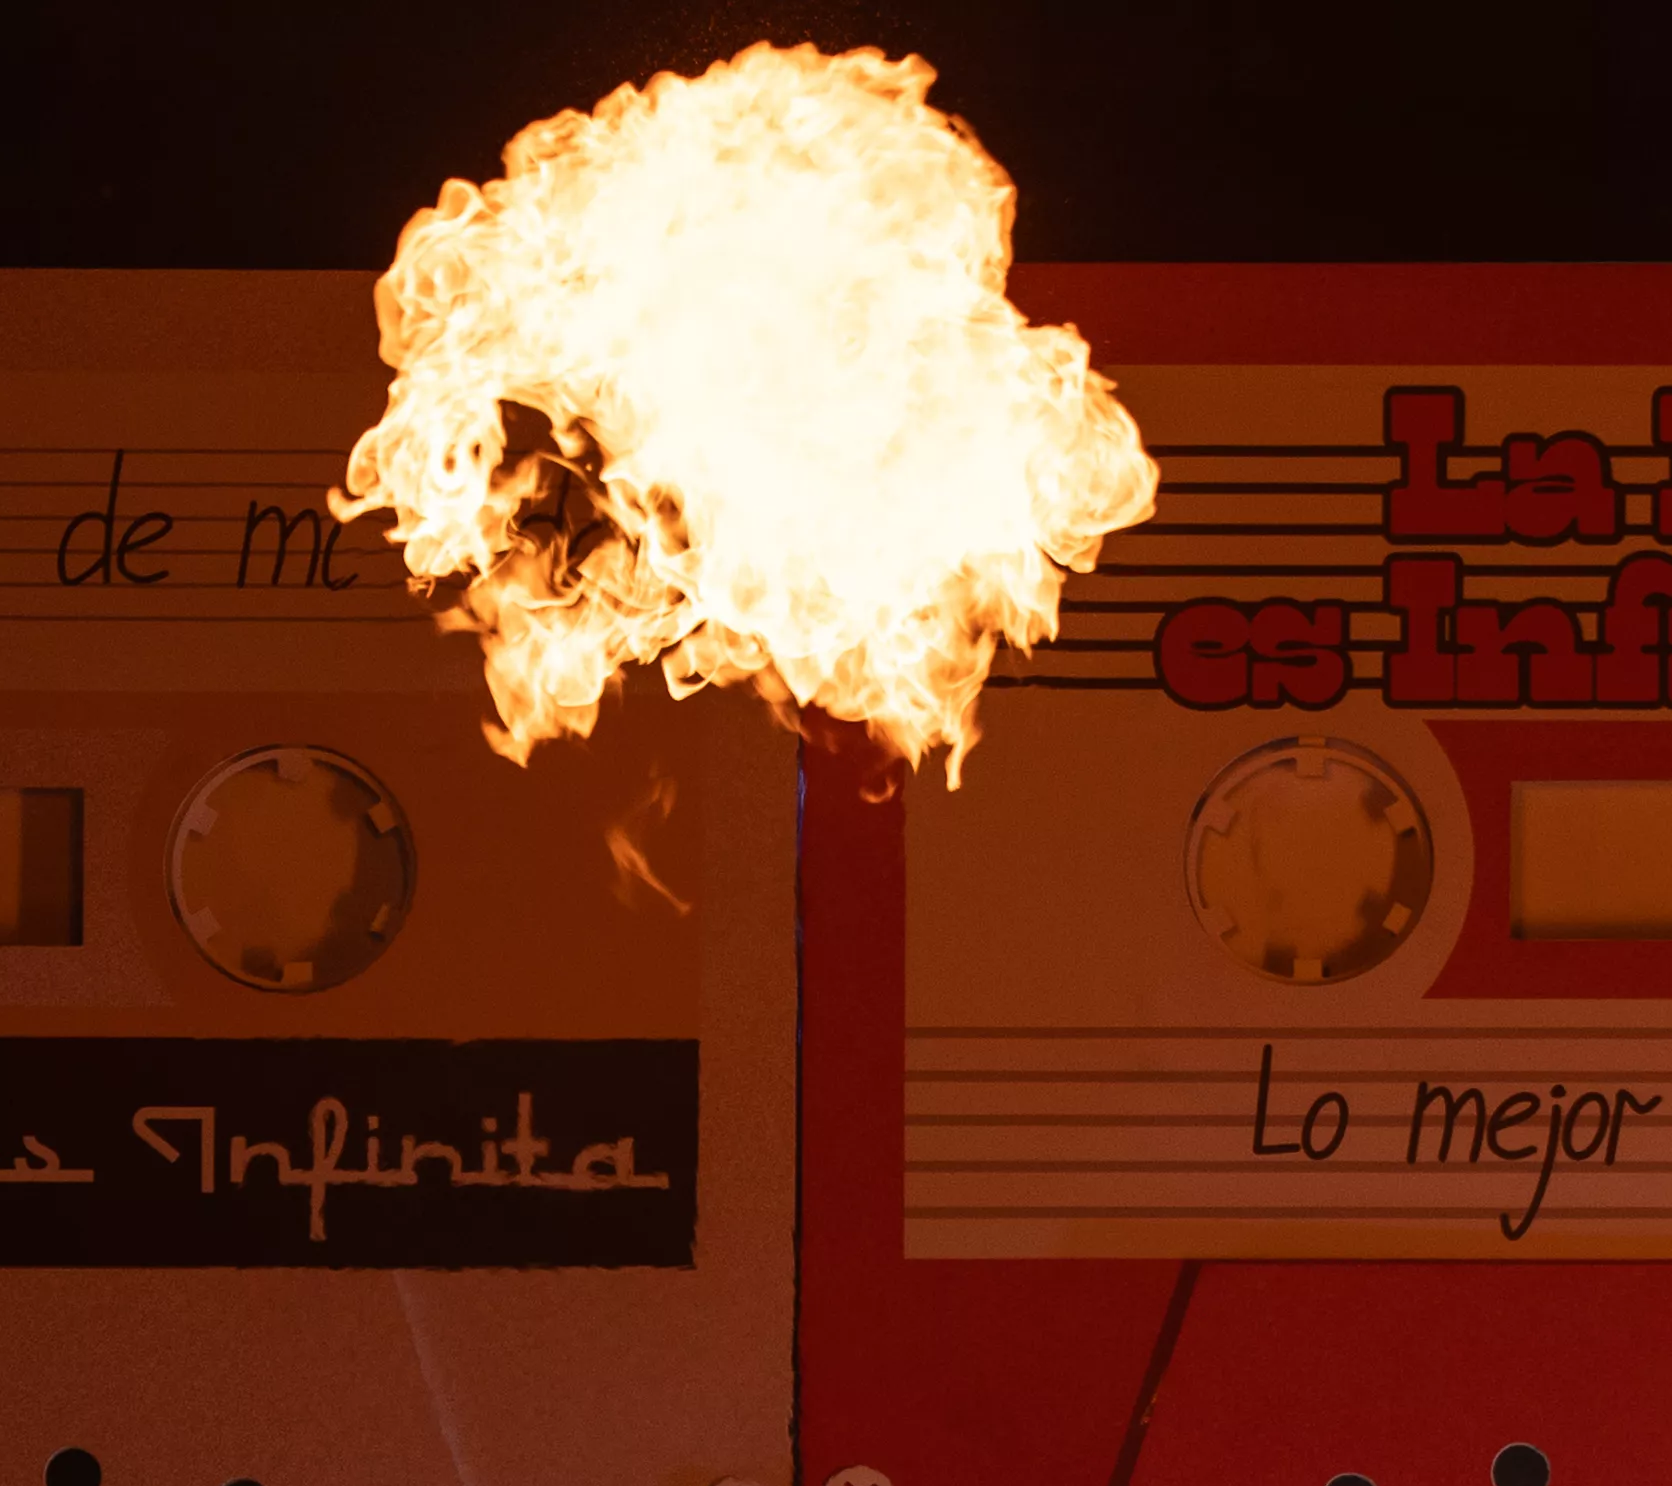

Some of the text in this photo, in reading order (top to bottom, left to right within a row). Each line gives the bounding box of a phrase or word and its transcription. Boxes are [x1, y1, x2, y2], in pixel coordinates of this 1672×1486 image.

[56, 450, 172, 588] de
[1383, 386, 1617, 545] La
[1155, 597, 1350, 711] es
[131, 1094, 669, 1245] Infinita
[1253, 1043, 1347, 1159] Lo
[1406, 1078, 1661, 1241] mejor
